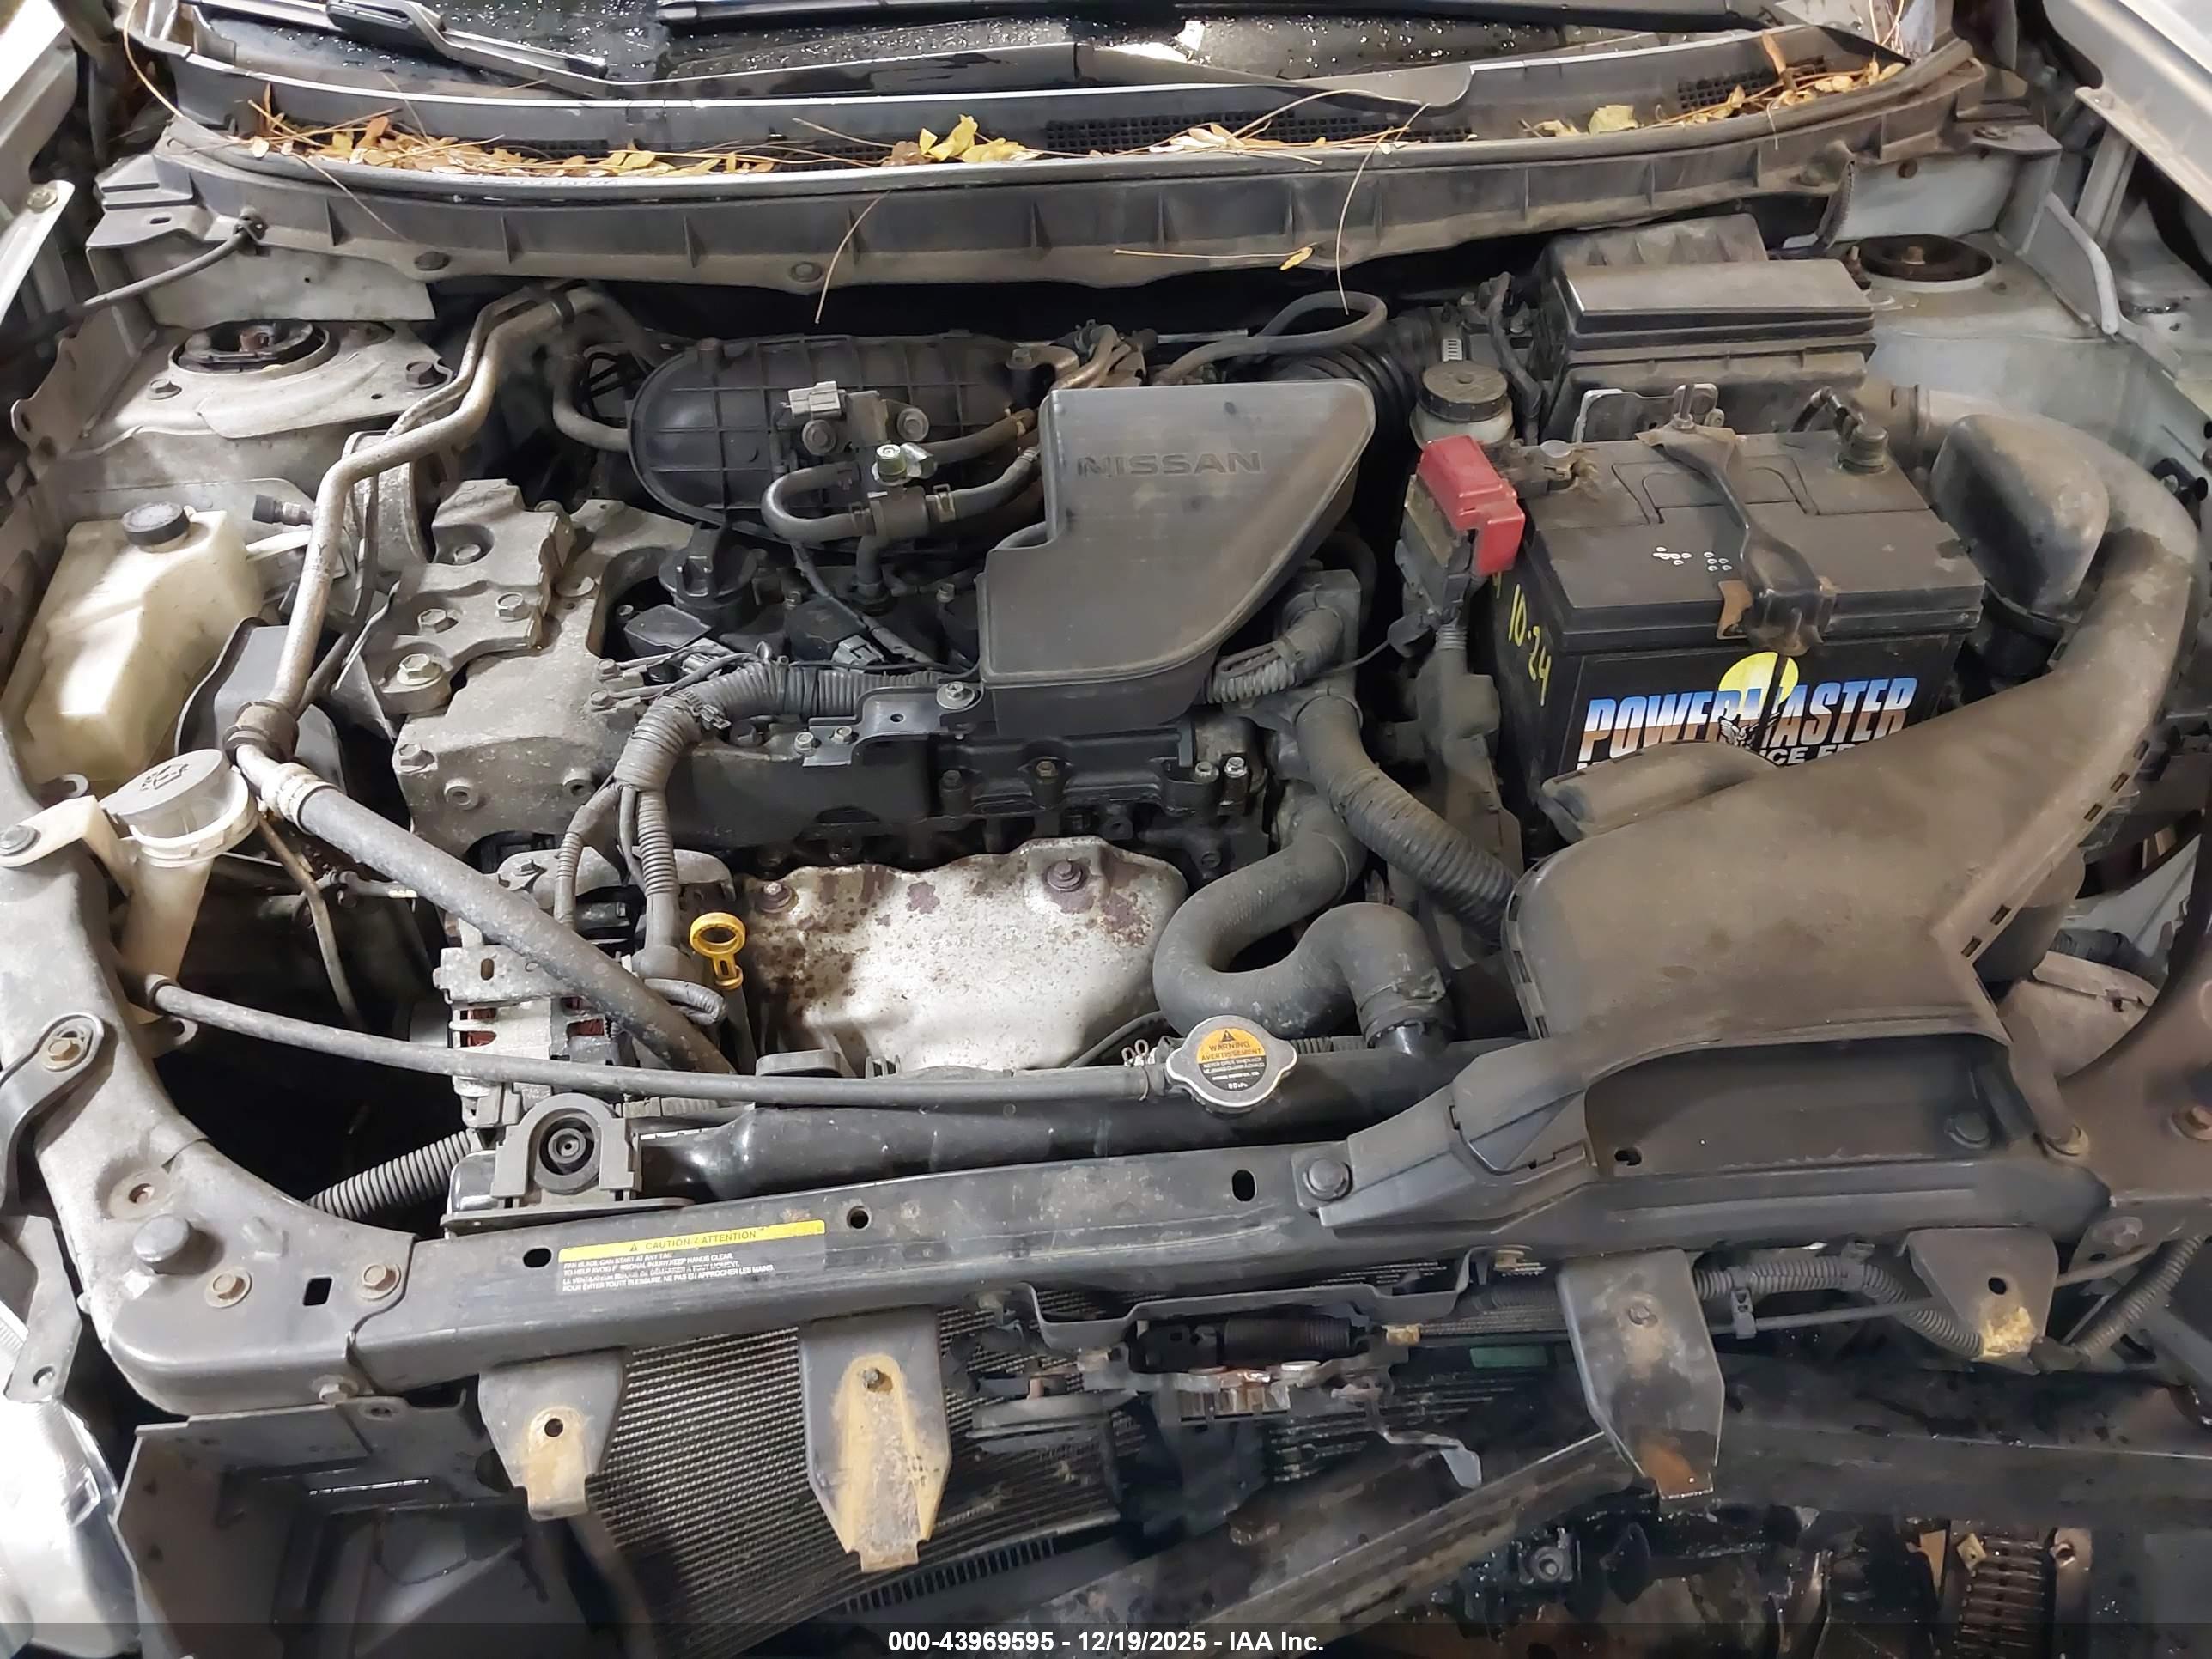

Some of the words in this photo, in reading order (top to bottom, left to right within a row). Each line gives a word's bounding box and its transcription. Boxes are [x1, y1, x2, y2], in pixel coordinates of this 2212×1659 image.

[1078, 452, 1261, 476] NISSAN
[1209, 1041, 1251, 1052] WARNING
[646, 1238, 690, 1249] CAUTION
[702, 1231, 757, 1244] ATTENTION
